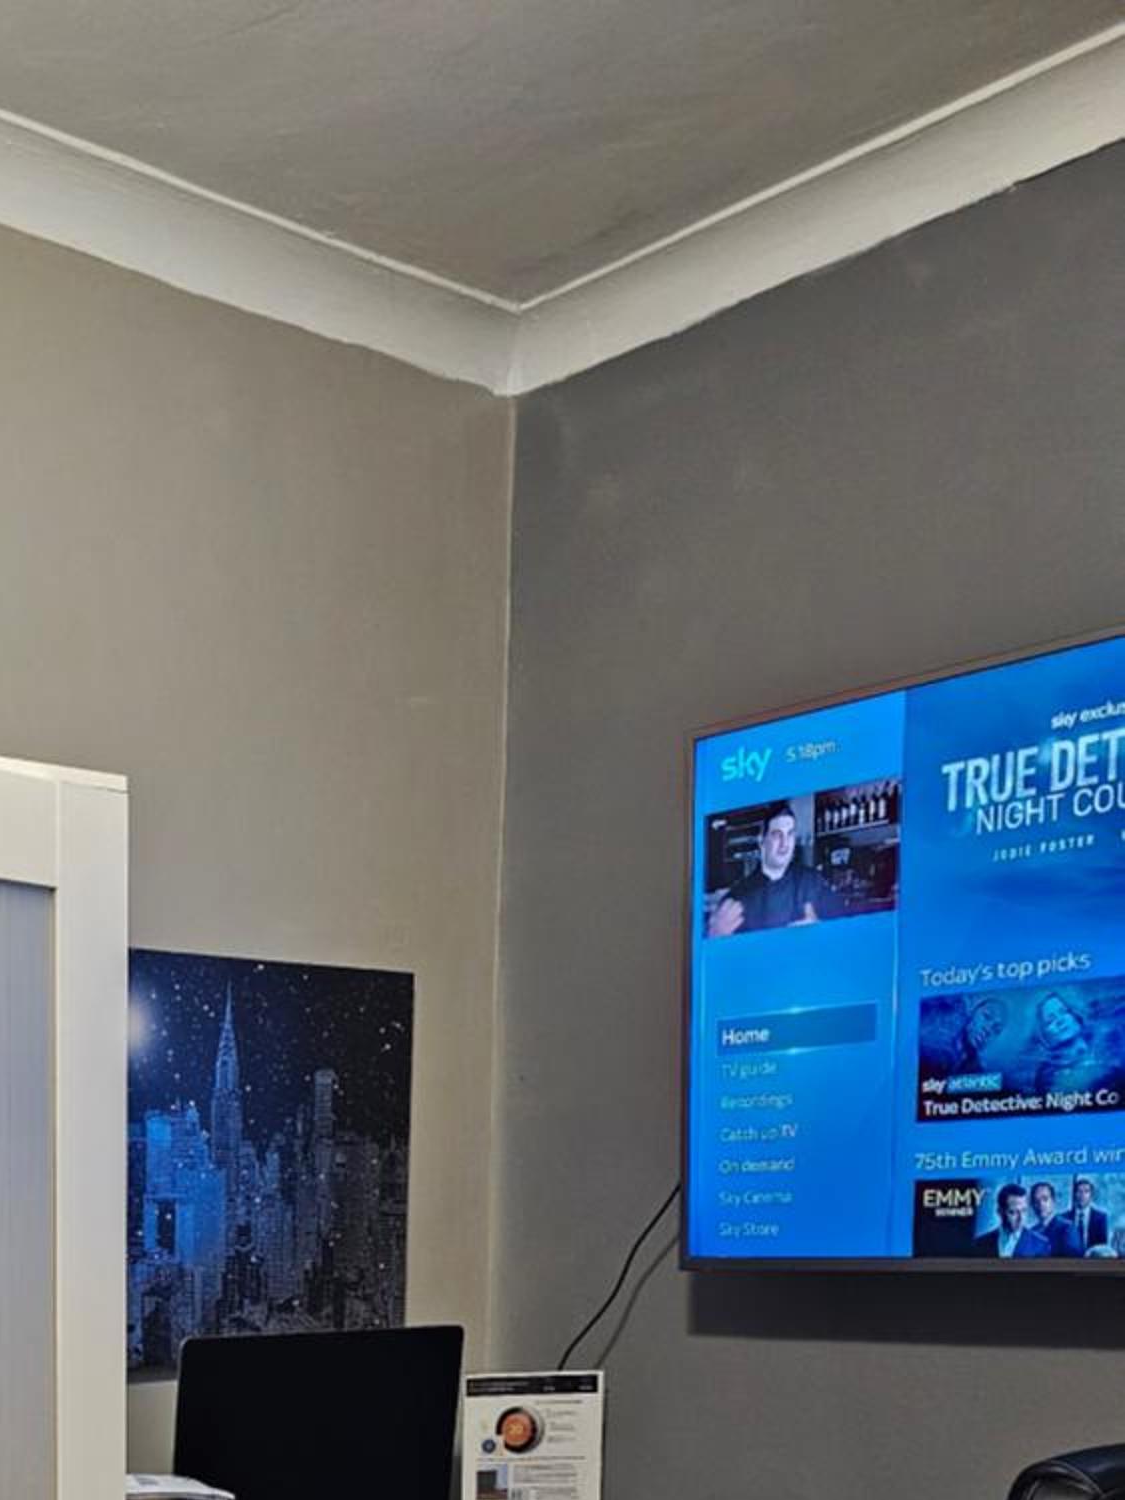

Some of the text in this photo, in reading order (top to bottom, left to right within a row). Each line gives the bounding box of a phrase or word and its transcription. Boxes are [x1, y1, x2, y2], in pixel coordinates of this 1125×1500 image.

[1051, 711, 1077, 730] sky
[721, 746, 773, 782] sky
[941, 727, 1125, 812] TRUE DET
[976, 793, 1065, 835] NIGHT
[993, 834, 1095, 862] JODIE FOSTER
[920, 952, 1092, 987] Today's top picks
[722, 1028, 770, 1046] Home
[923, 1077, 948, 1094] sky
[923, 1099, 959, 1117] True
[961, 1093, 1043, 1114] Detective:
[1046, 1090, 1092, 1112] Night
[741, 1157, 795, 1173] demand
[915, 1151, 957, 1171] 75th
[961, 1150, 1019, 1169] Emmy
[1023, 1147, 1088, 1166] Award
[923, 1188, 986, 1208] EMMY
